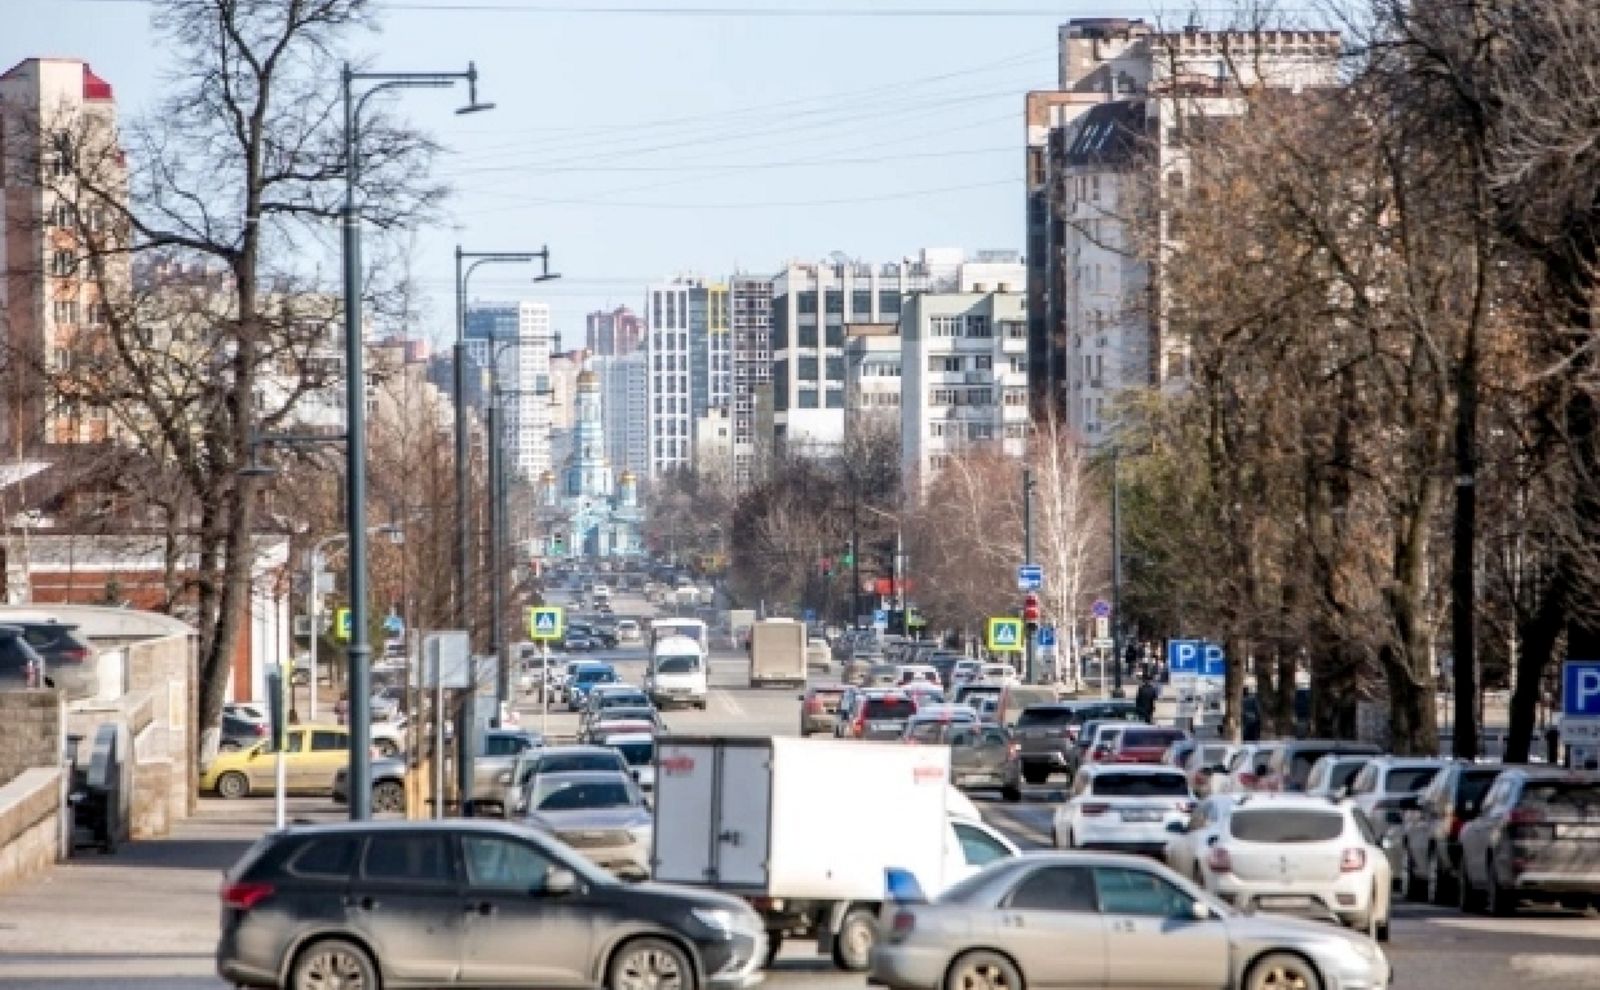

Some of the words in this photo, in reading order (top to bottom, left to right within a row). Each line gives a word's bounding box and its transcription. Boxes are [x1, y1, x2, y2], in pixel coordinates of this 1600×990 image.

[1178, 644, 1196, 667] P
[1206, 646, 1223, 673] P
[1576, 667, 1600, 710] P
